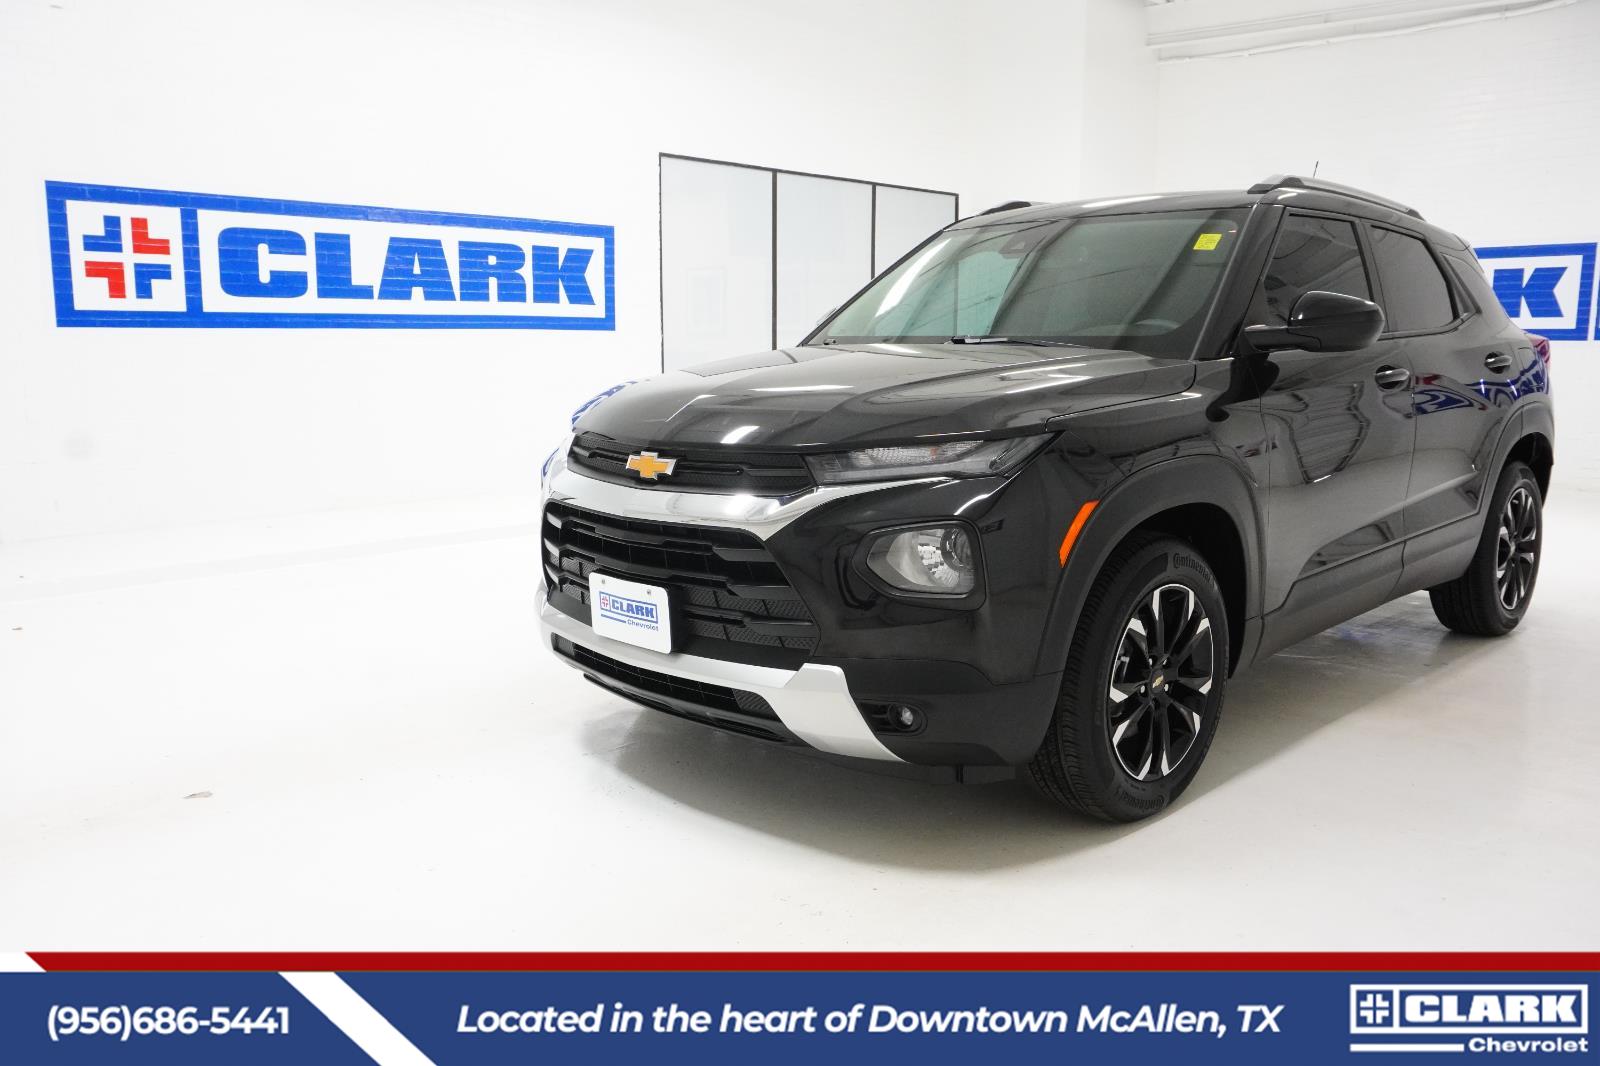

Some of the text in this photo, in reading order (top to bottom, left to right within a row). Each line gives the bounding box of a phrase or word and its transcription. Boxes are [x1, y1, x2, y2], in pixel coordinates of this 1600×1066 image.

[217, 226, 596, 306] CLARK
[611, 598, 655, 619] CLARK
[627, 619, 659, 632] Chevrolet
